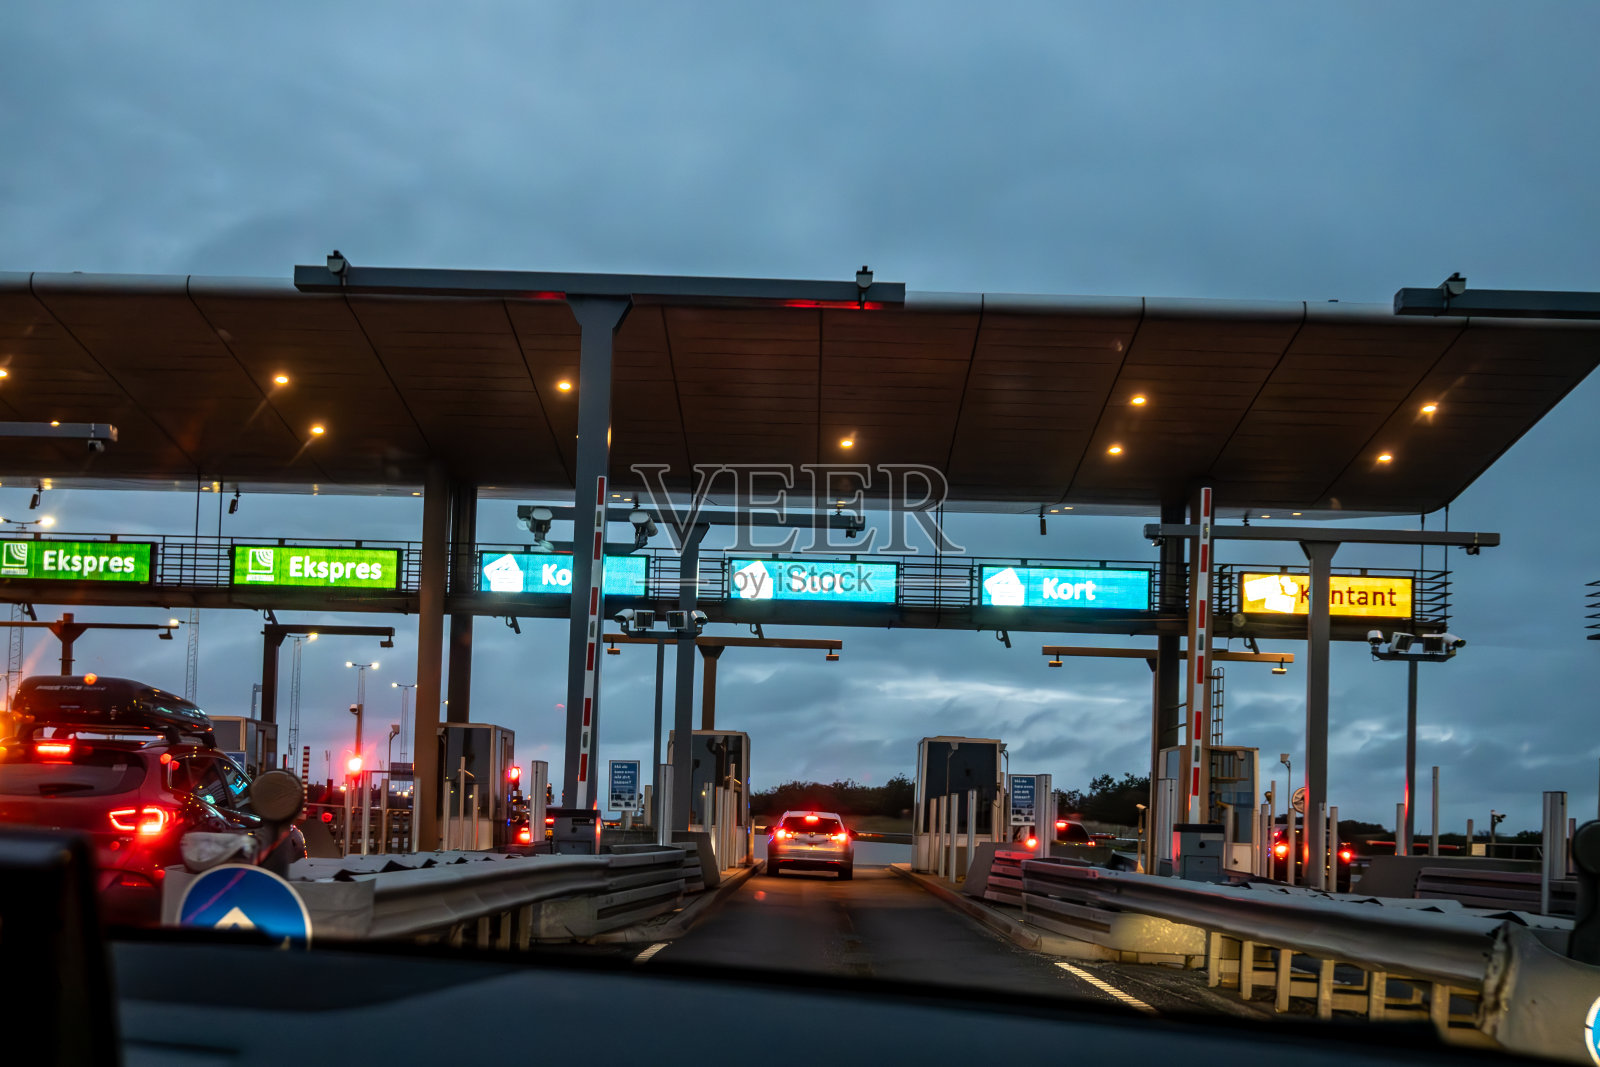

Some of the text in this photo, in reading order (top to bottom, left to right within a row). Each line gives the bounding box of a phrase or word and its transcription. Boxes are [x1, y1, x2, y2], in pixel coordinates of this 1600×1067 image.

[43, 549, 136, 577] Ekspres
[289, 556, 382, 584] Ekspres
[541, 563, 573, 587] Ko
[1042, 577, 1097, 601] Kort
[1301, 584, 1397, 607] Kntant
